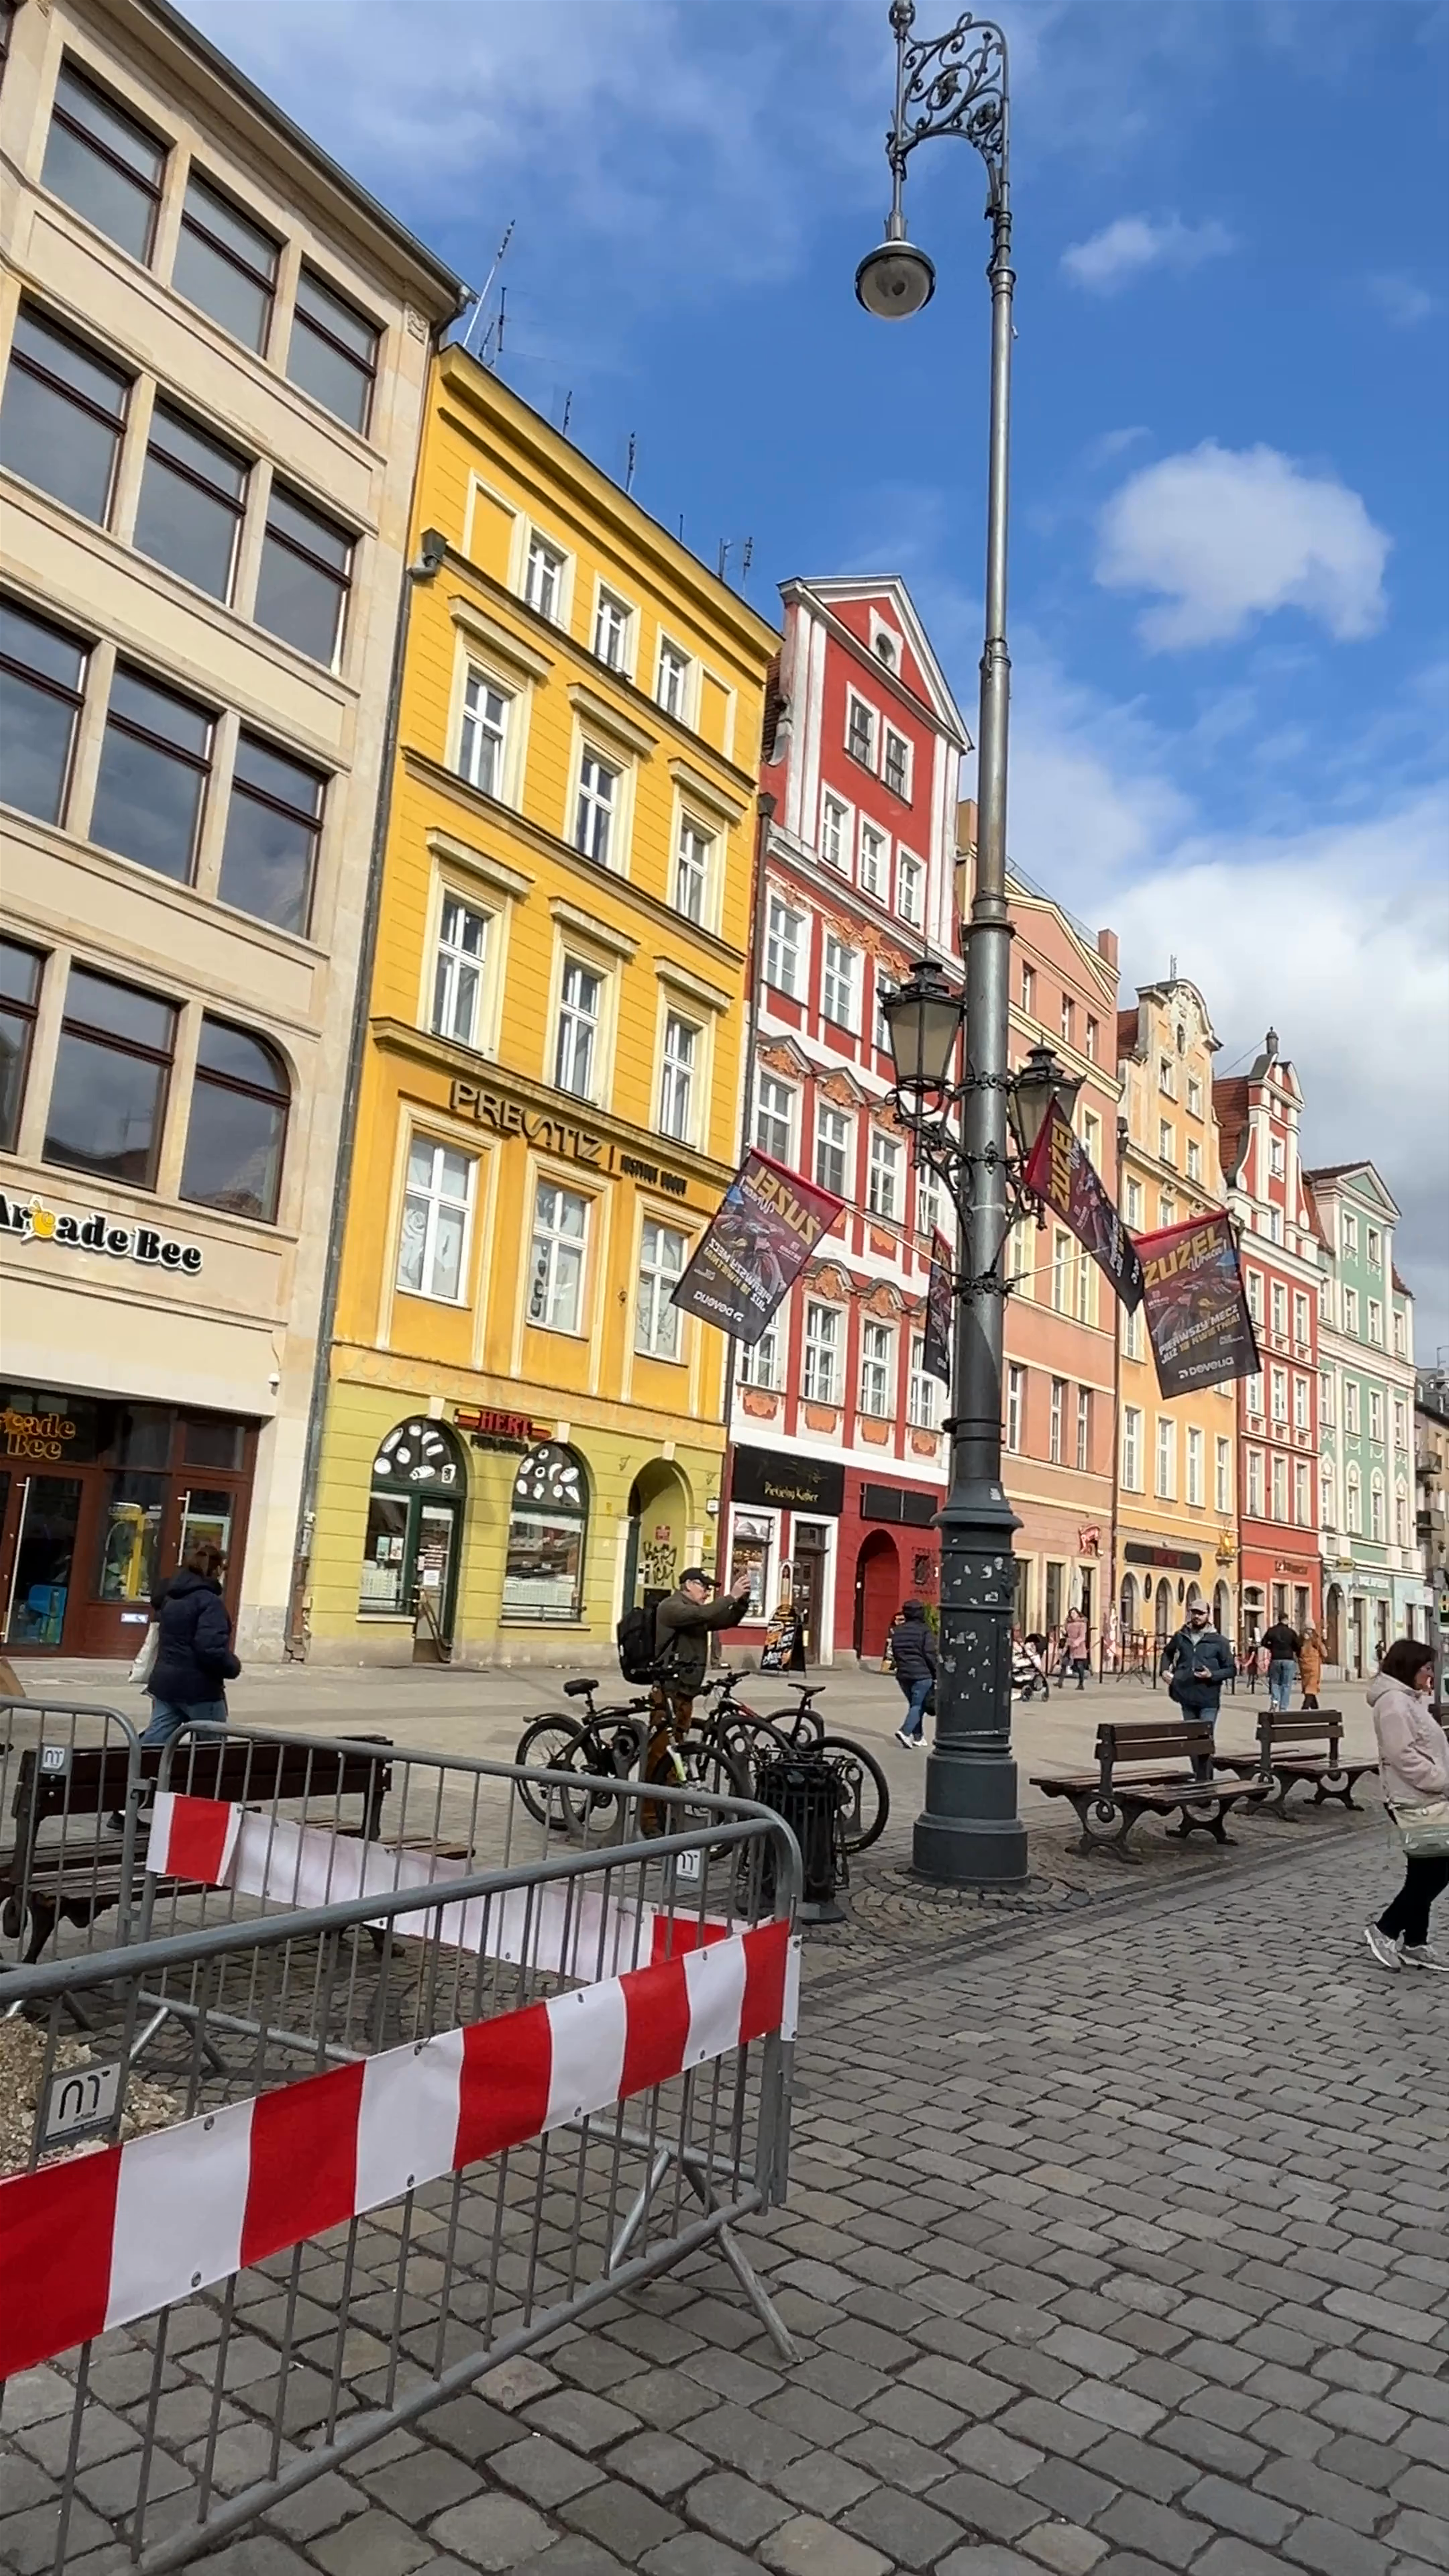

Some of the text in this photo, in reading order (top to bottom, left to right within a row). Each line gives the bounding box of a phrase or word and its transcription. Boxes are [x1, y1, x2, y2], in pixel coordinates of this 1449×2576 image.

[137, 1229, 201, 1269] Bee
[1143, 1226, 1223, 1289] ŻUŻEL
[1211, 1304, 1238, 1325] MECZ
[7, 1432, 62, 1459] Bee
